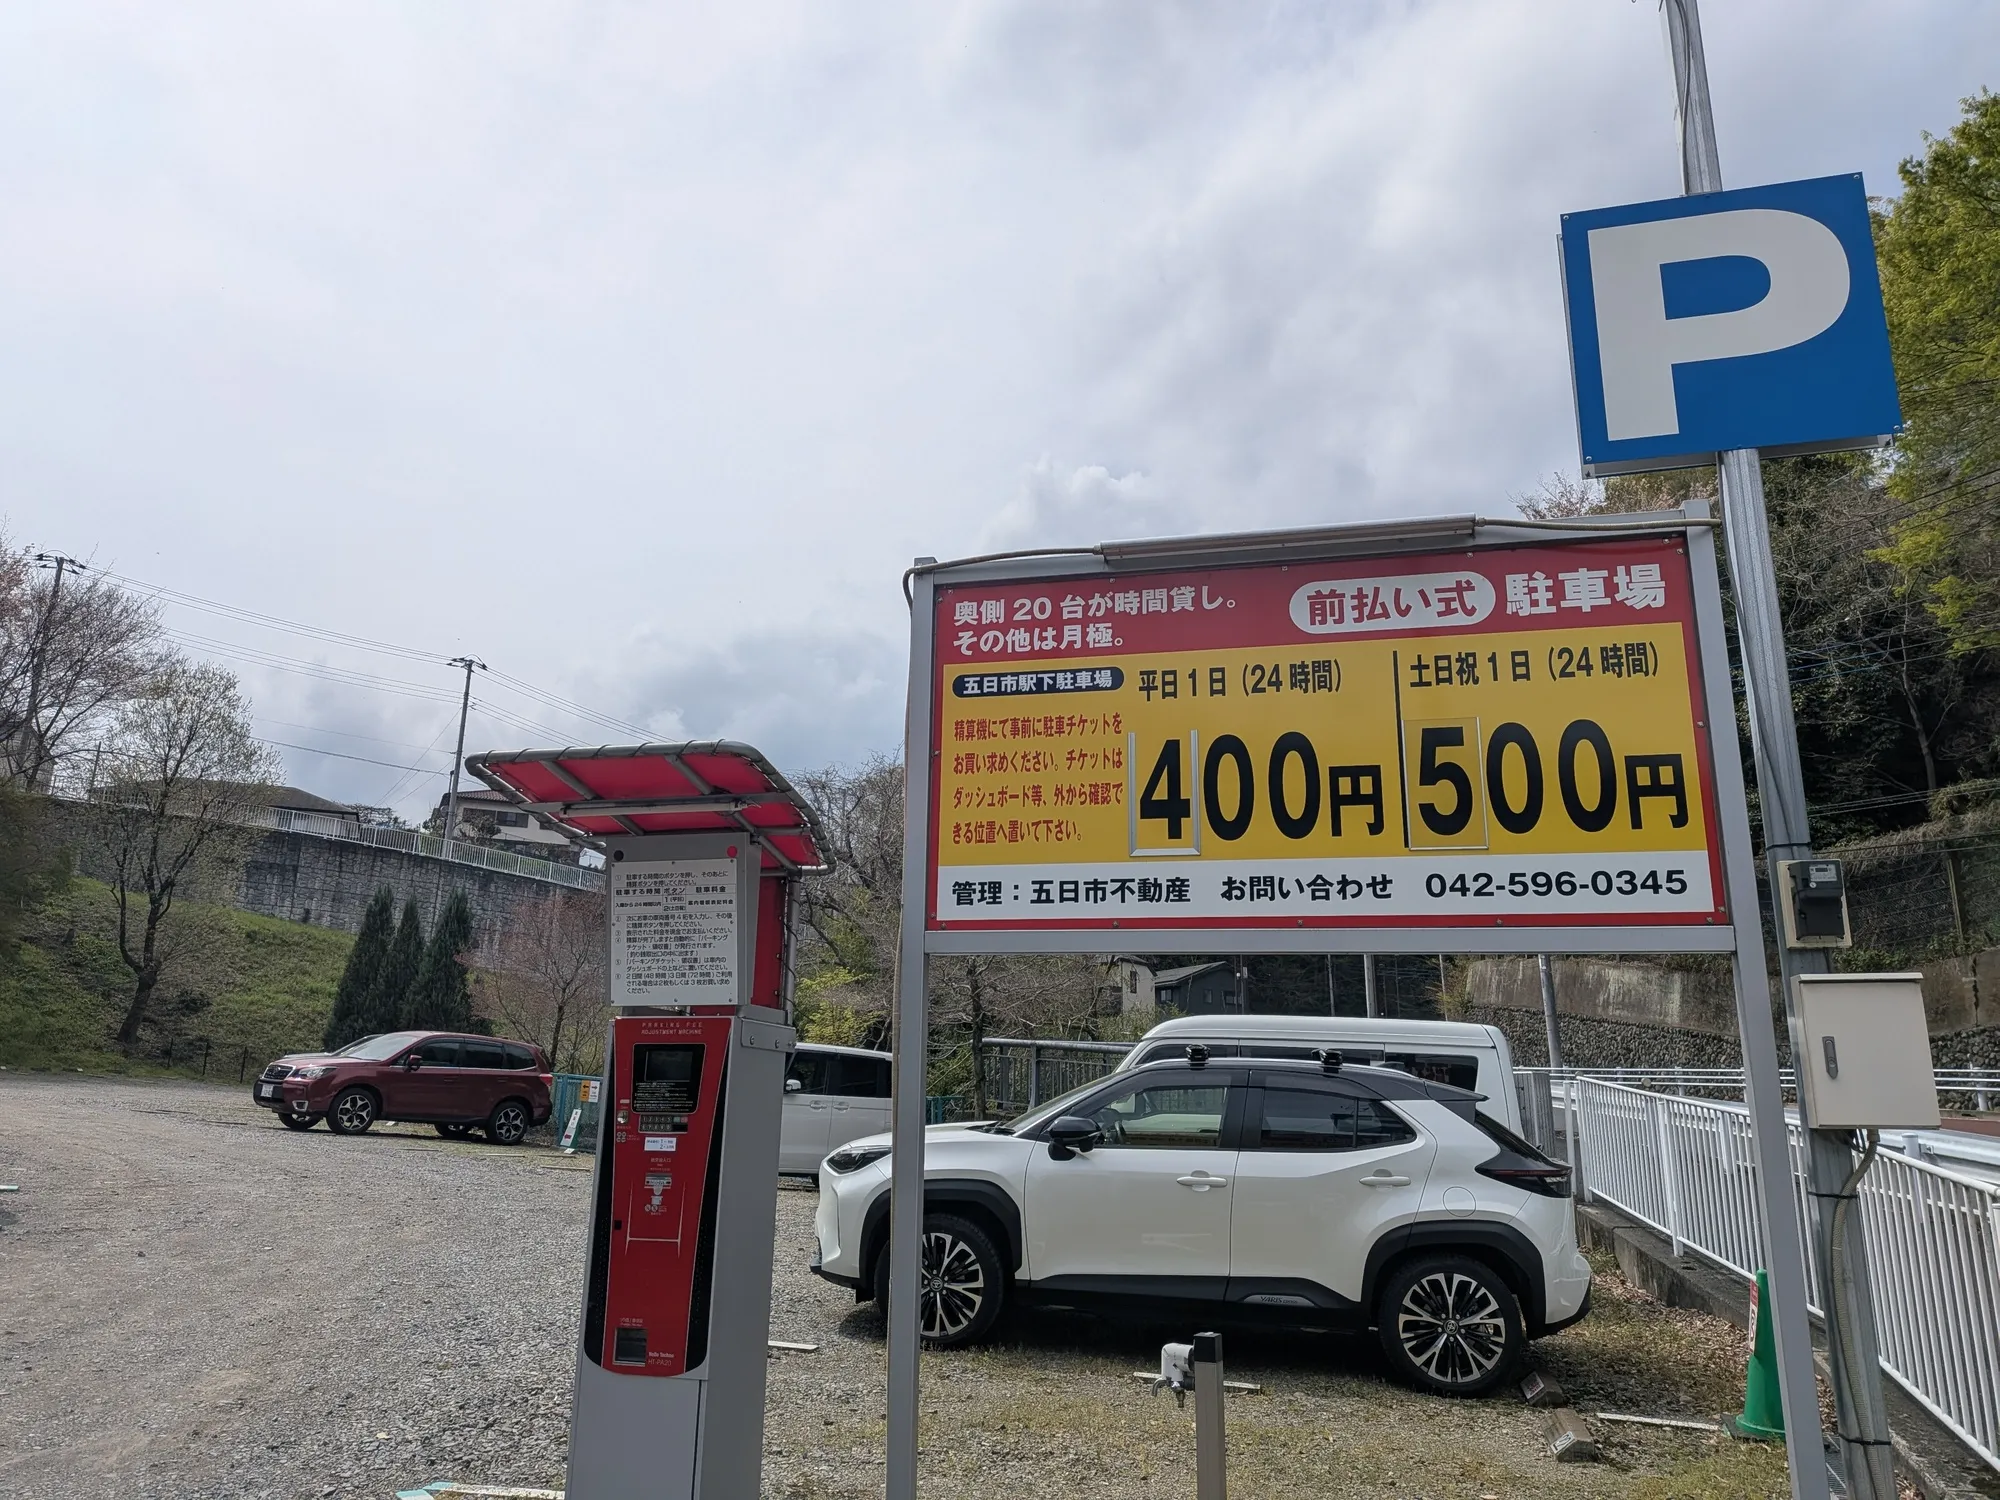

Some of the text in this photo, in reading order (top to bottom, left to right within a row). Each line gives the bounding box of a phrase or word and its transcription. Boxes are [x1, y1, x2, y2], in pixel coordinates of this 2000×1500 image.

[1587, 208, 1850, 441] P
[953, 586, 1236, 626] 奥側20台が時間貸し。
[1306, 563, 1666, 626] 前払い式 駐車場
[953, 623, 1124, 656] その他は月極。
[963, 671, 1112, 695] 五日市駅下駐車場
[954, 712, 1122, 741] 精算機にて事前に駐車チケットを
[953, 747, 1122, 775] お買い求めください。チケットは
[1418, 719, 1689, 836] 500円
[953, 782, 1123, 809] ダッシュボード等、外から確認で
[1139, 731, 1385, 841] 400円
[952, 818, 1082, 845] きる位置へ置いて下さい。
[952, 869, 1688, 906] 管理：五日市不動産 お問い合わせ 042-596-0345
